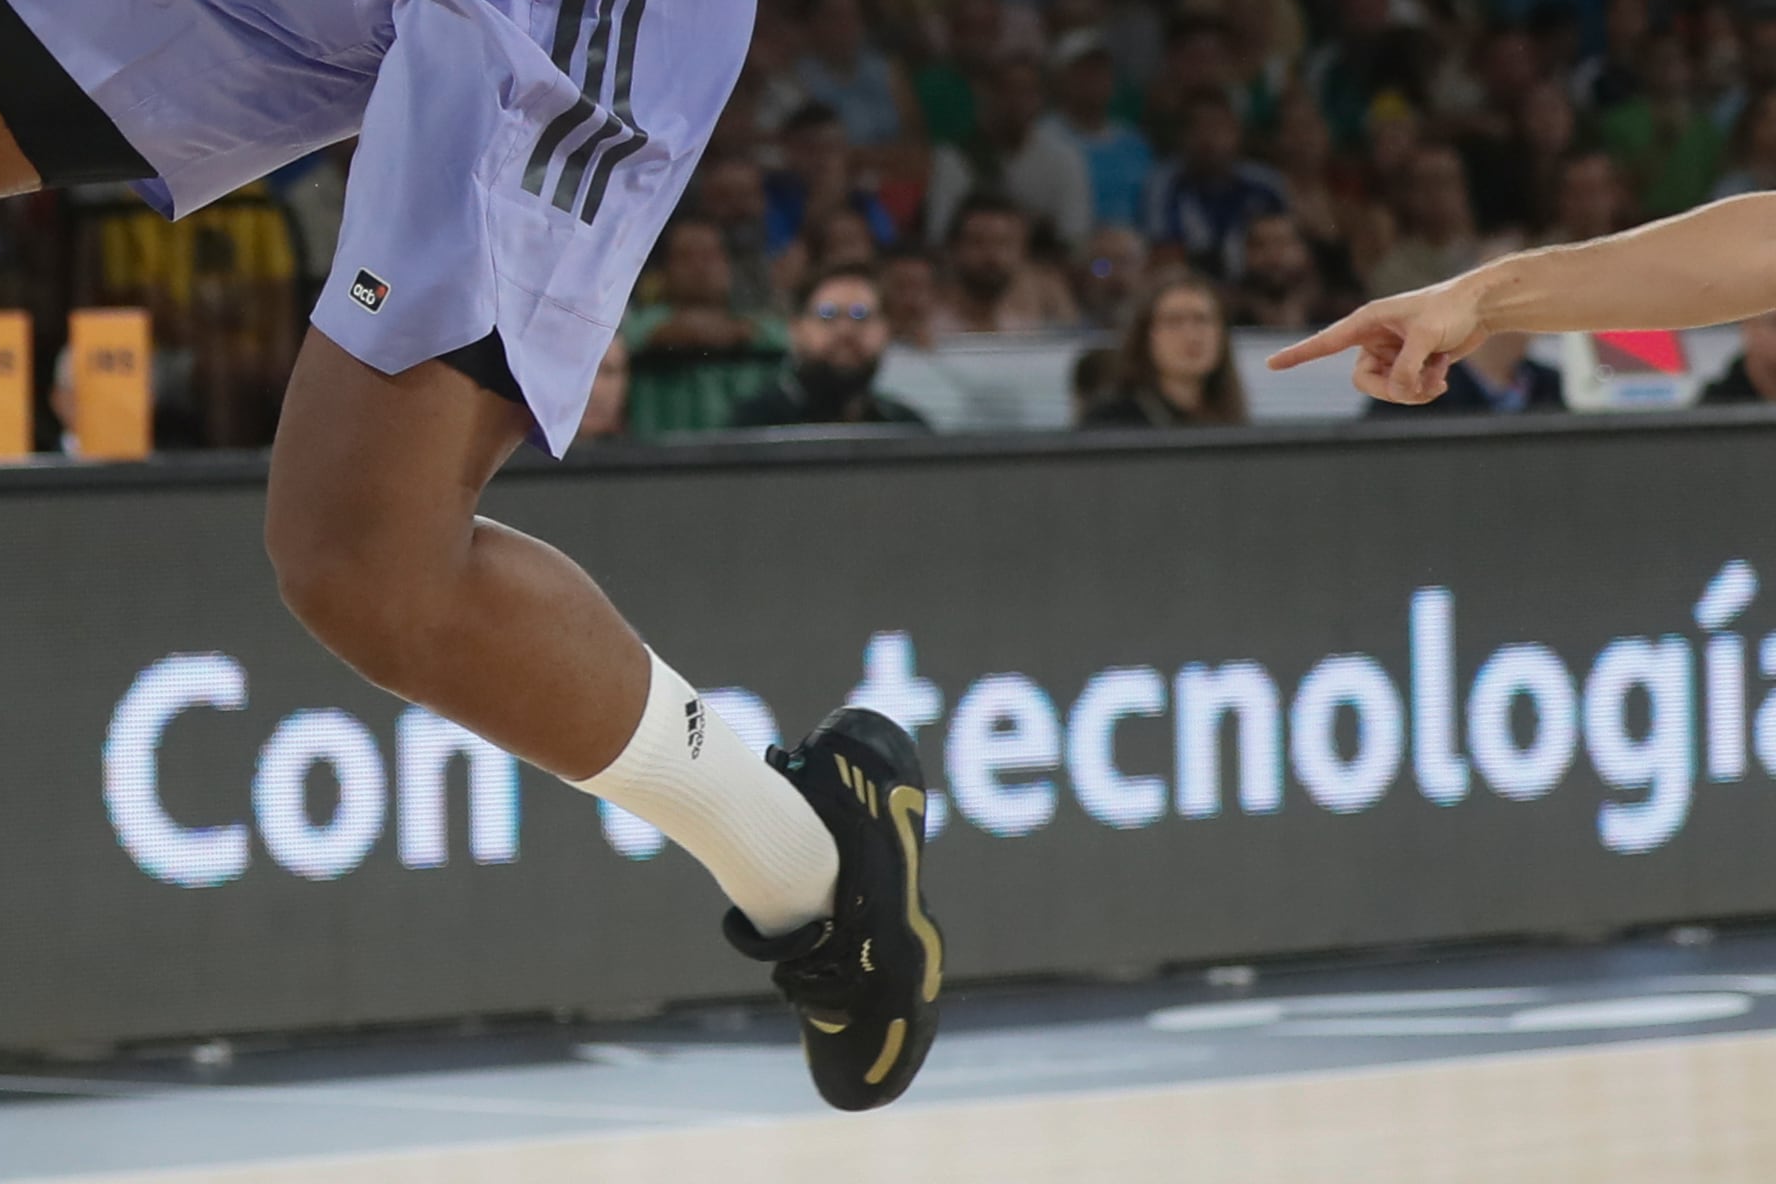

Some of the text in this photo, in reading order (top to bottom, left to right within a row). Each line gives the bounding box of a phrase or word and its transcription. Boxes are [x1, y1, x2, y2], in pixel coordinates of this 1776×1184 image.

[353, 283, 376, 305] acb
[101, 650, 522, 889] Con
[842, 558, 1776, 858] tecnologí
